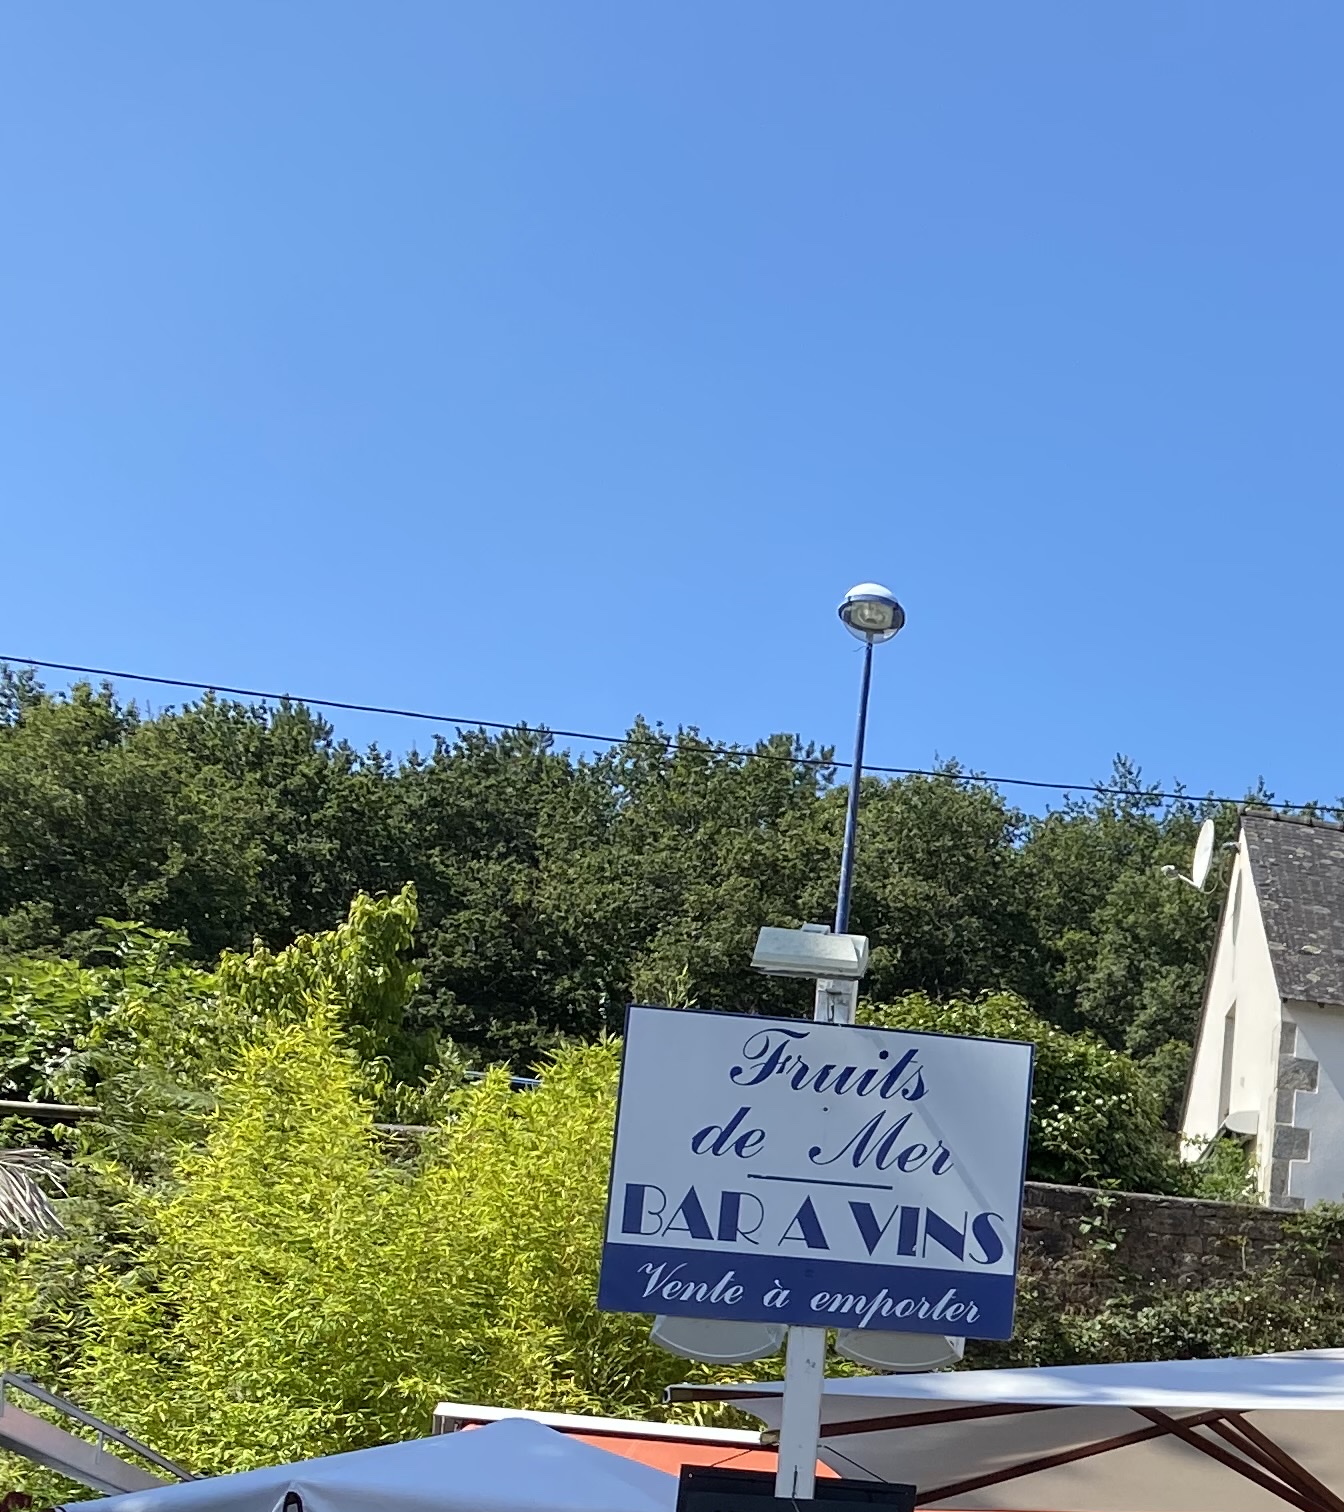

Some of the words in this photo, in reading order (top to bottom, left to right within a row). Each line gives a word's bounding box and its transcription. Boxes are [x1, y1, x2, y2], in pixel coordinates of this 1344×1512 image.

[729, 1028, 929, 1101] Fruits
[691, 1106, 766, 1158] de
[808, 1109, 955, 1176] Mer
[621, 1182, 764, 1246] BAR
[778, 1194, 830, 1250] A
[848, 1200, 1005, 1264] VINS
[638, 1262, 744, 1305] Vente
[763, 1278, 789, 1308] à
[810, 1288, 981, 1328] emporter
